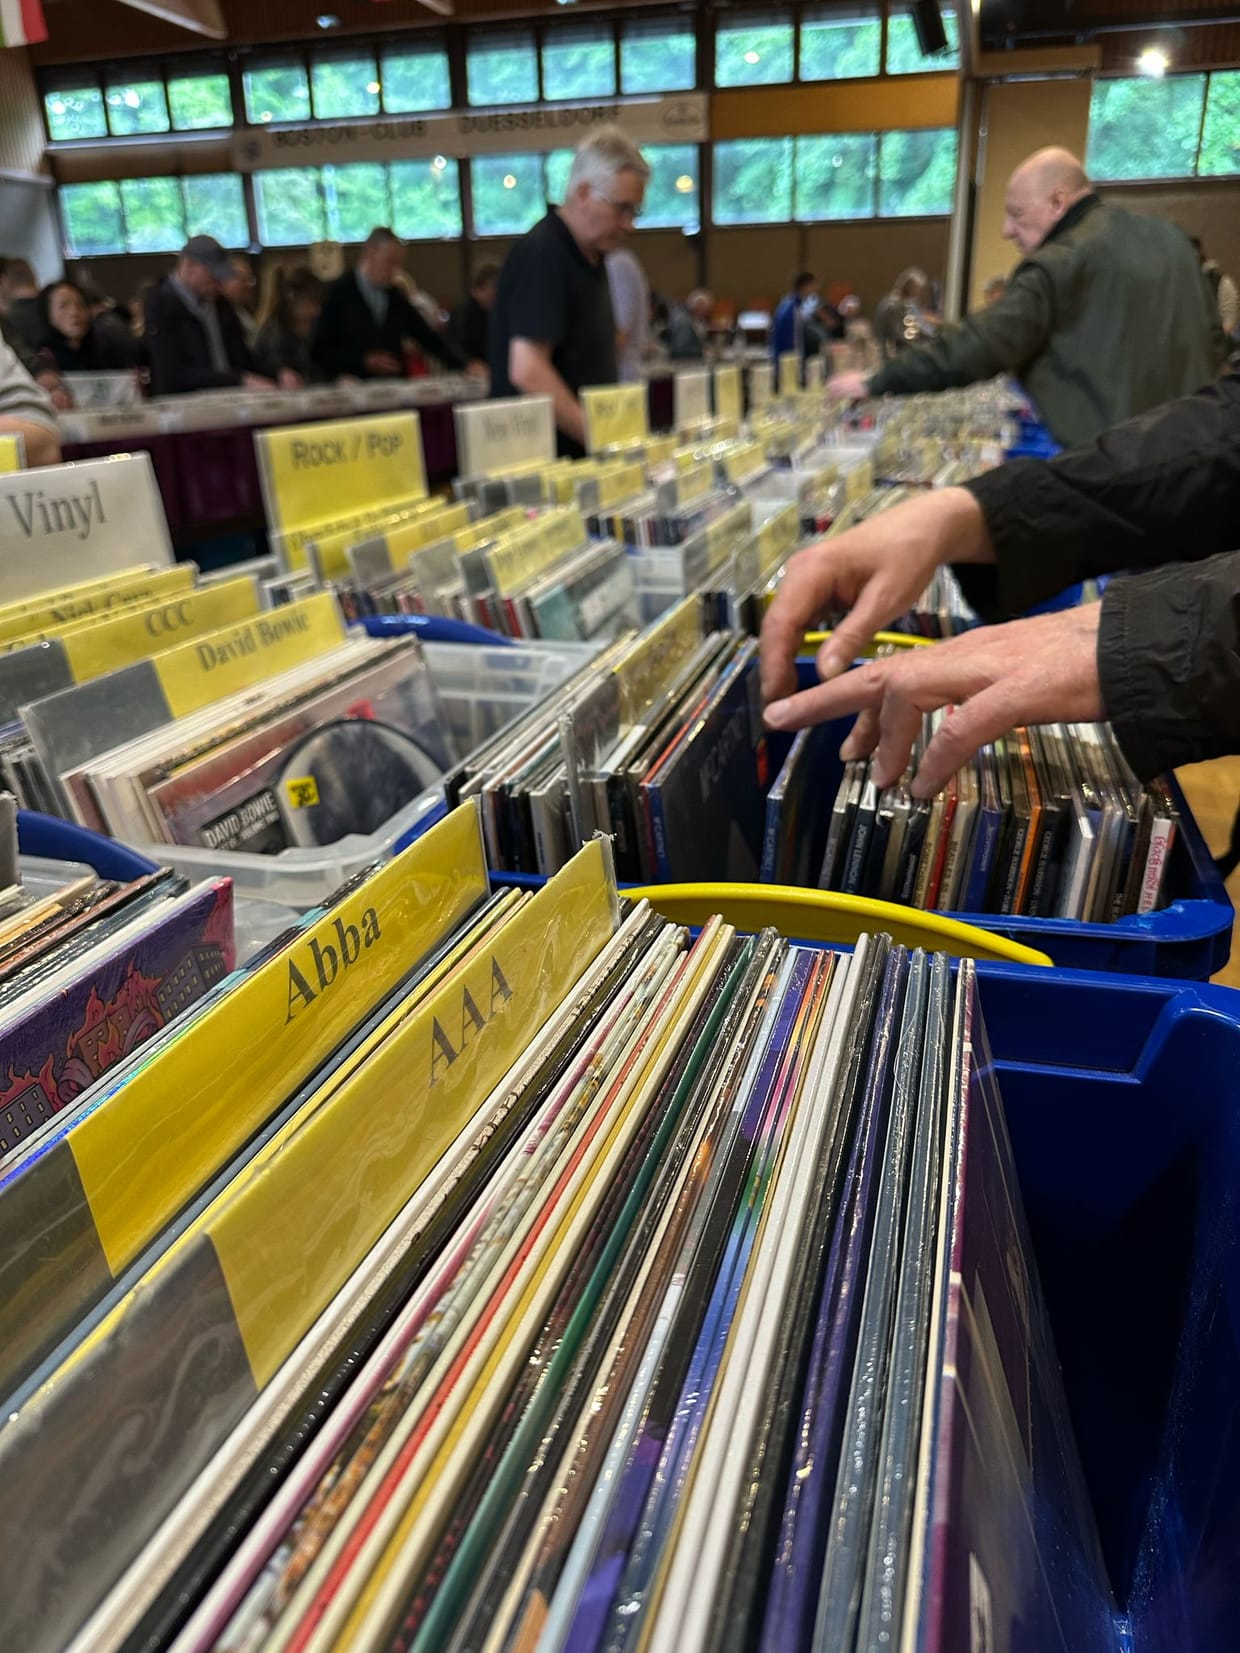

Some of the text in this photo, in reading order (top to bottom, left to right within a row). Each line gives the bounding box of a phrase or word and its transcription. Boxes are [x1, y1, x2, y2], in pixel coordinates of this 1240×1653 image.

[6, 478, 108, 541] Vinyl
[146, 600, 192, 637] CCC
[196, 610, 311, 672] David Bowie
[203, 814, 240, 849] DAVID
[240, 791, 277, 827] BOWIE
[855, 823, 869, 850] JOHN
[848, 849, 863, 885] LENNON
[284, 907, 382, 1025] Abba
[428, 955, 514, 1088] AAA
